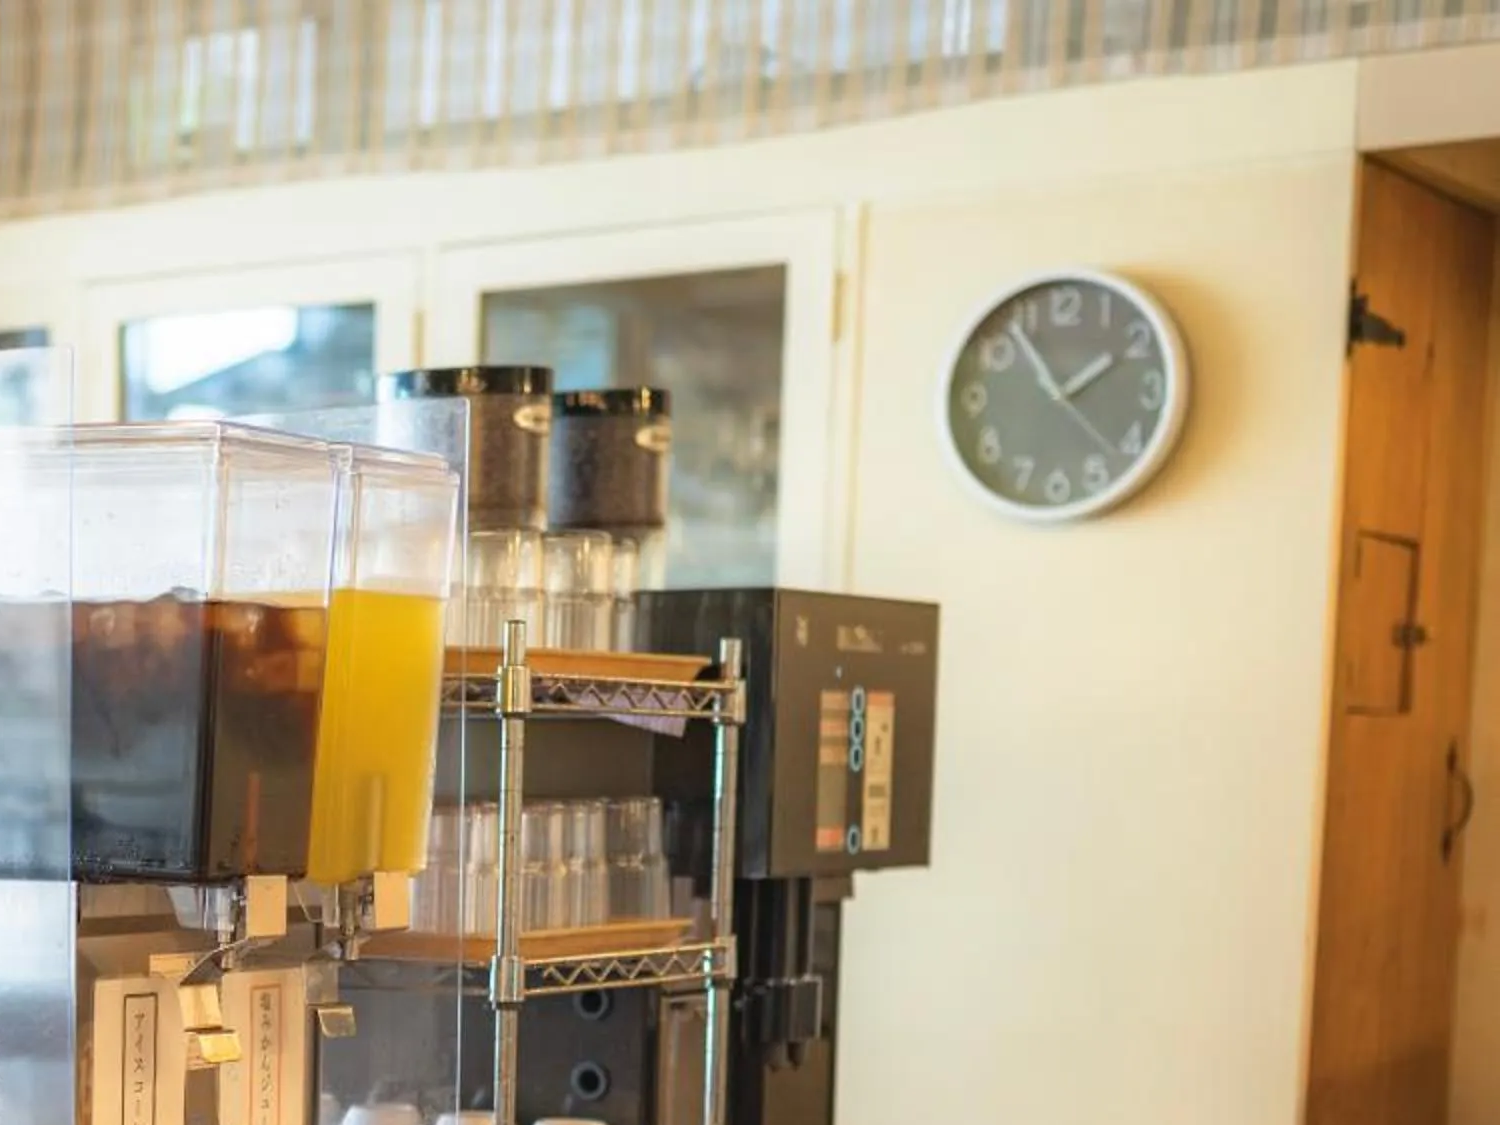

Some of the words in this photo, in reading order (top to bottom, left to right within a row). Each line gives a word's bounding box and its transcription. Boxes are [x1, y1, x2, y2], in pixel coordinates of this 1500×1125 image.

[1051, 287, 1082, 327] 12
[1099, 293, 1111, 329] 1
[979, 333, 1015, 372] 10
[1124, 320, 1150, 359] 2
[960, 380, 988, 418] 9
[1139, 369, 1163, 411] 3
[1120, 421, 1143, 455] 4
[1012, 454, 1035, 493] 7
[1044, 468, 1071, 503] 6
